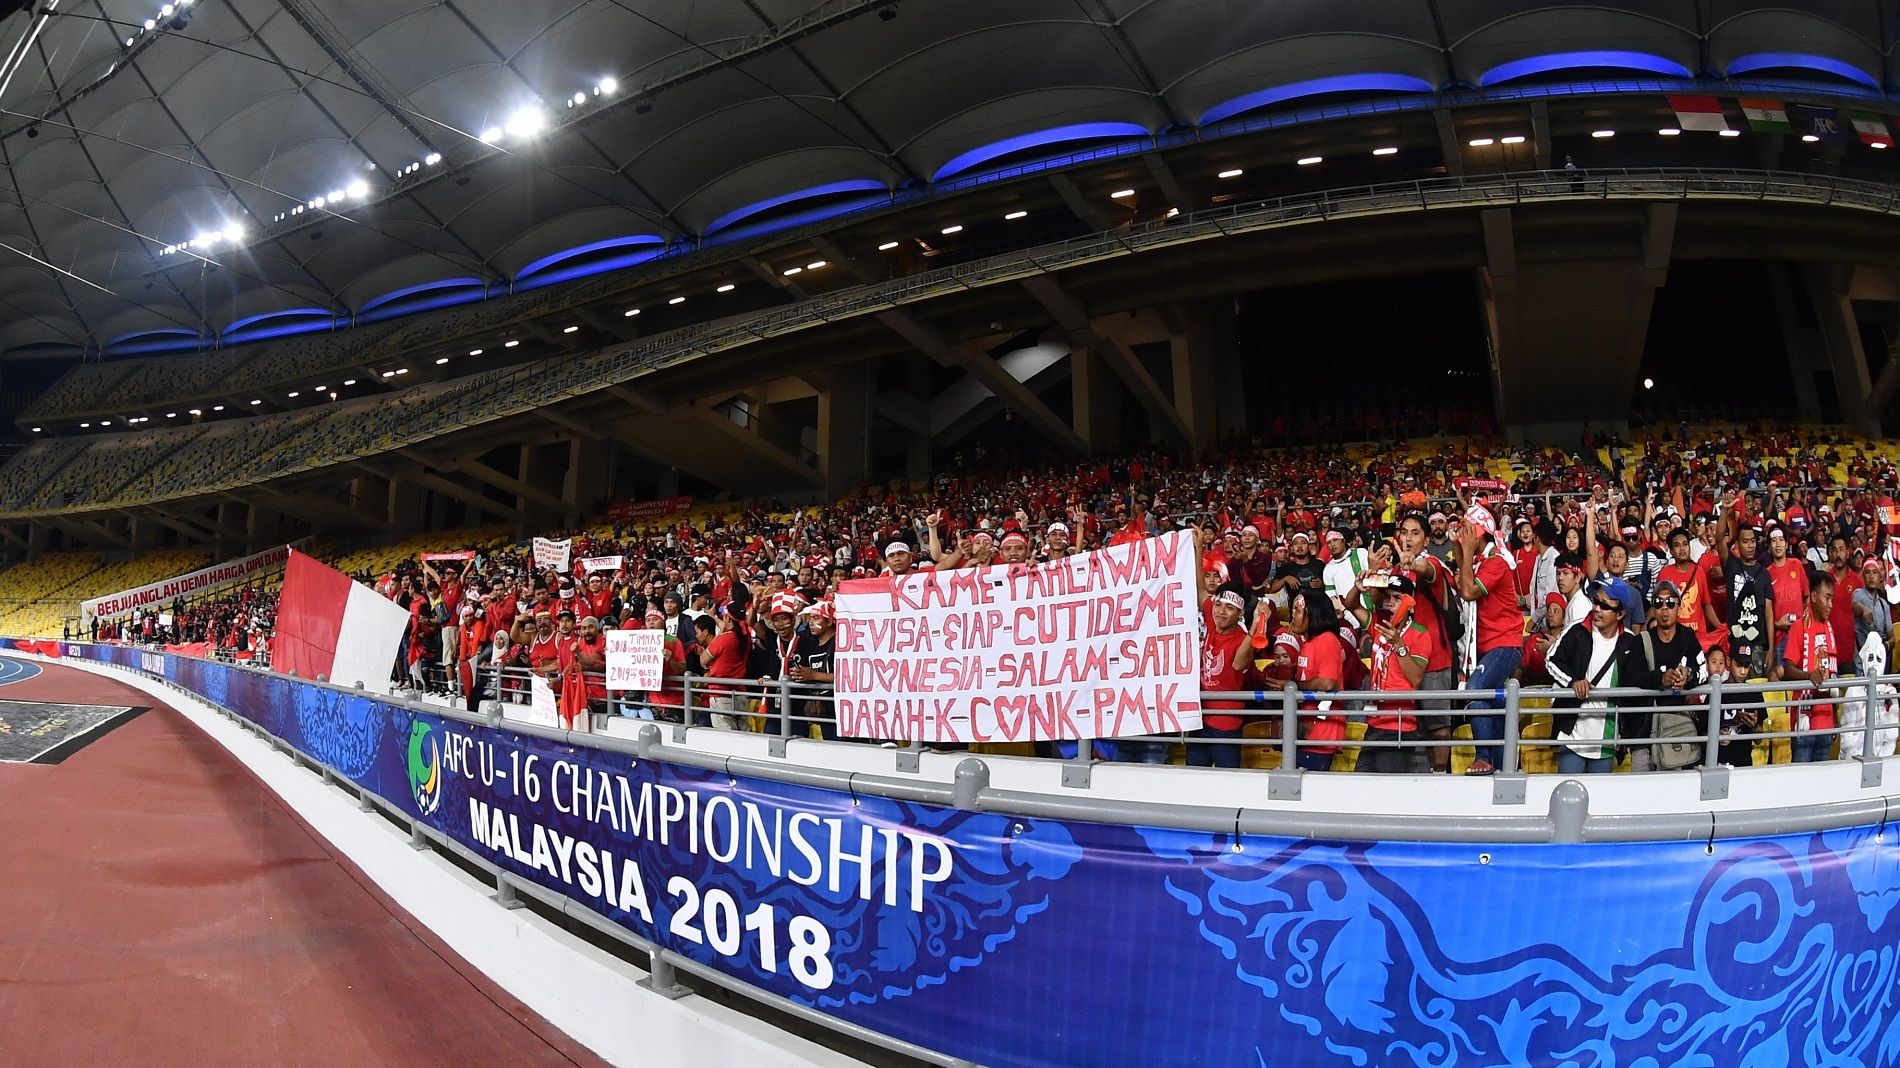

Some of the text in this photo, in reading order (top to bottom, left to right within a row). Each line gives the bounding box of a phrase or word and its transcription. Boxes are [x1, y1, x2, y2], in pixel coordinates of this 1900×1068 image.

[97, 584, 180, 617] BERJUANGLAH
[181, 573, 208, 593] DEMI
[209, 564, 245, 583] HARGA
[246, 557, 263, 572] DIRI
[610, 640, 628, 653] 2018
[631, 655, 660, 665] JUARA
[443, 731, 954, 913] AFC U-16 CHAMPIONSHIP
[469, 797, 835, 991] MALAYSIA 2018
